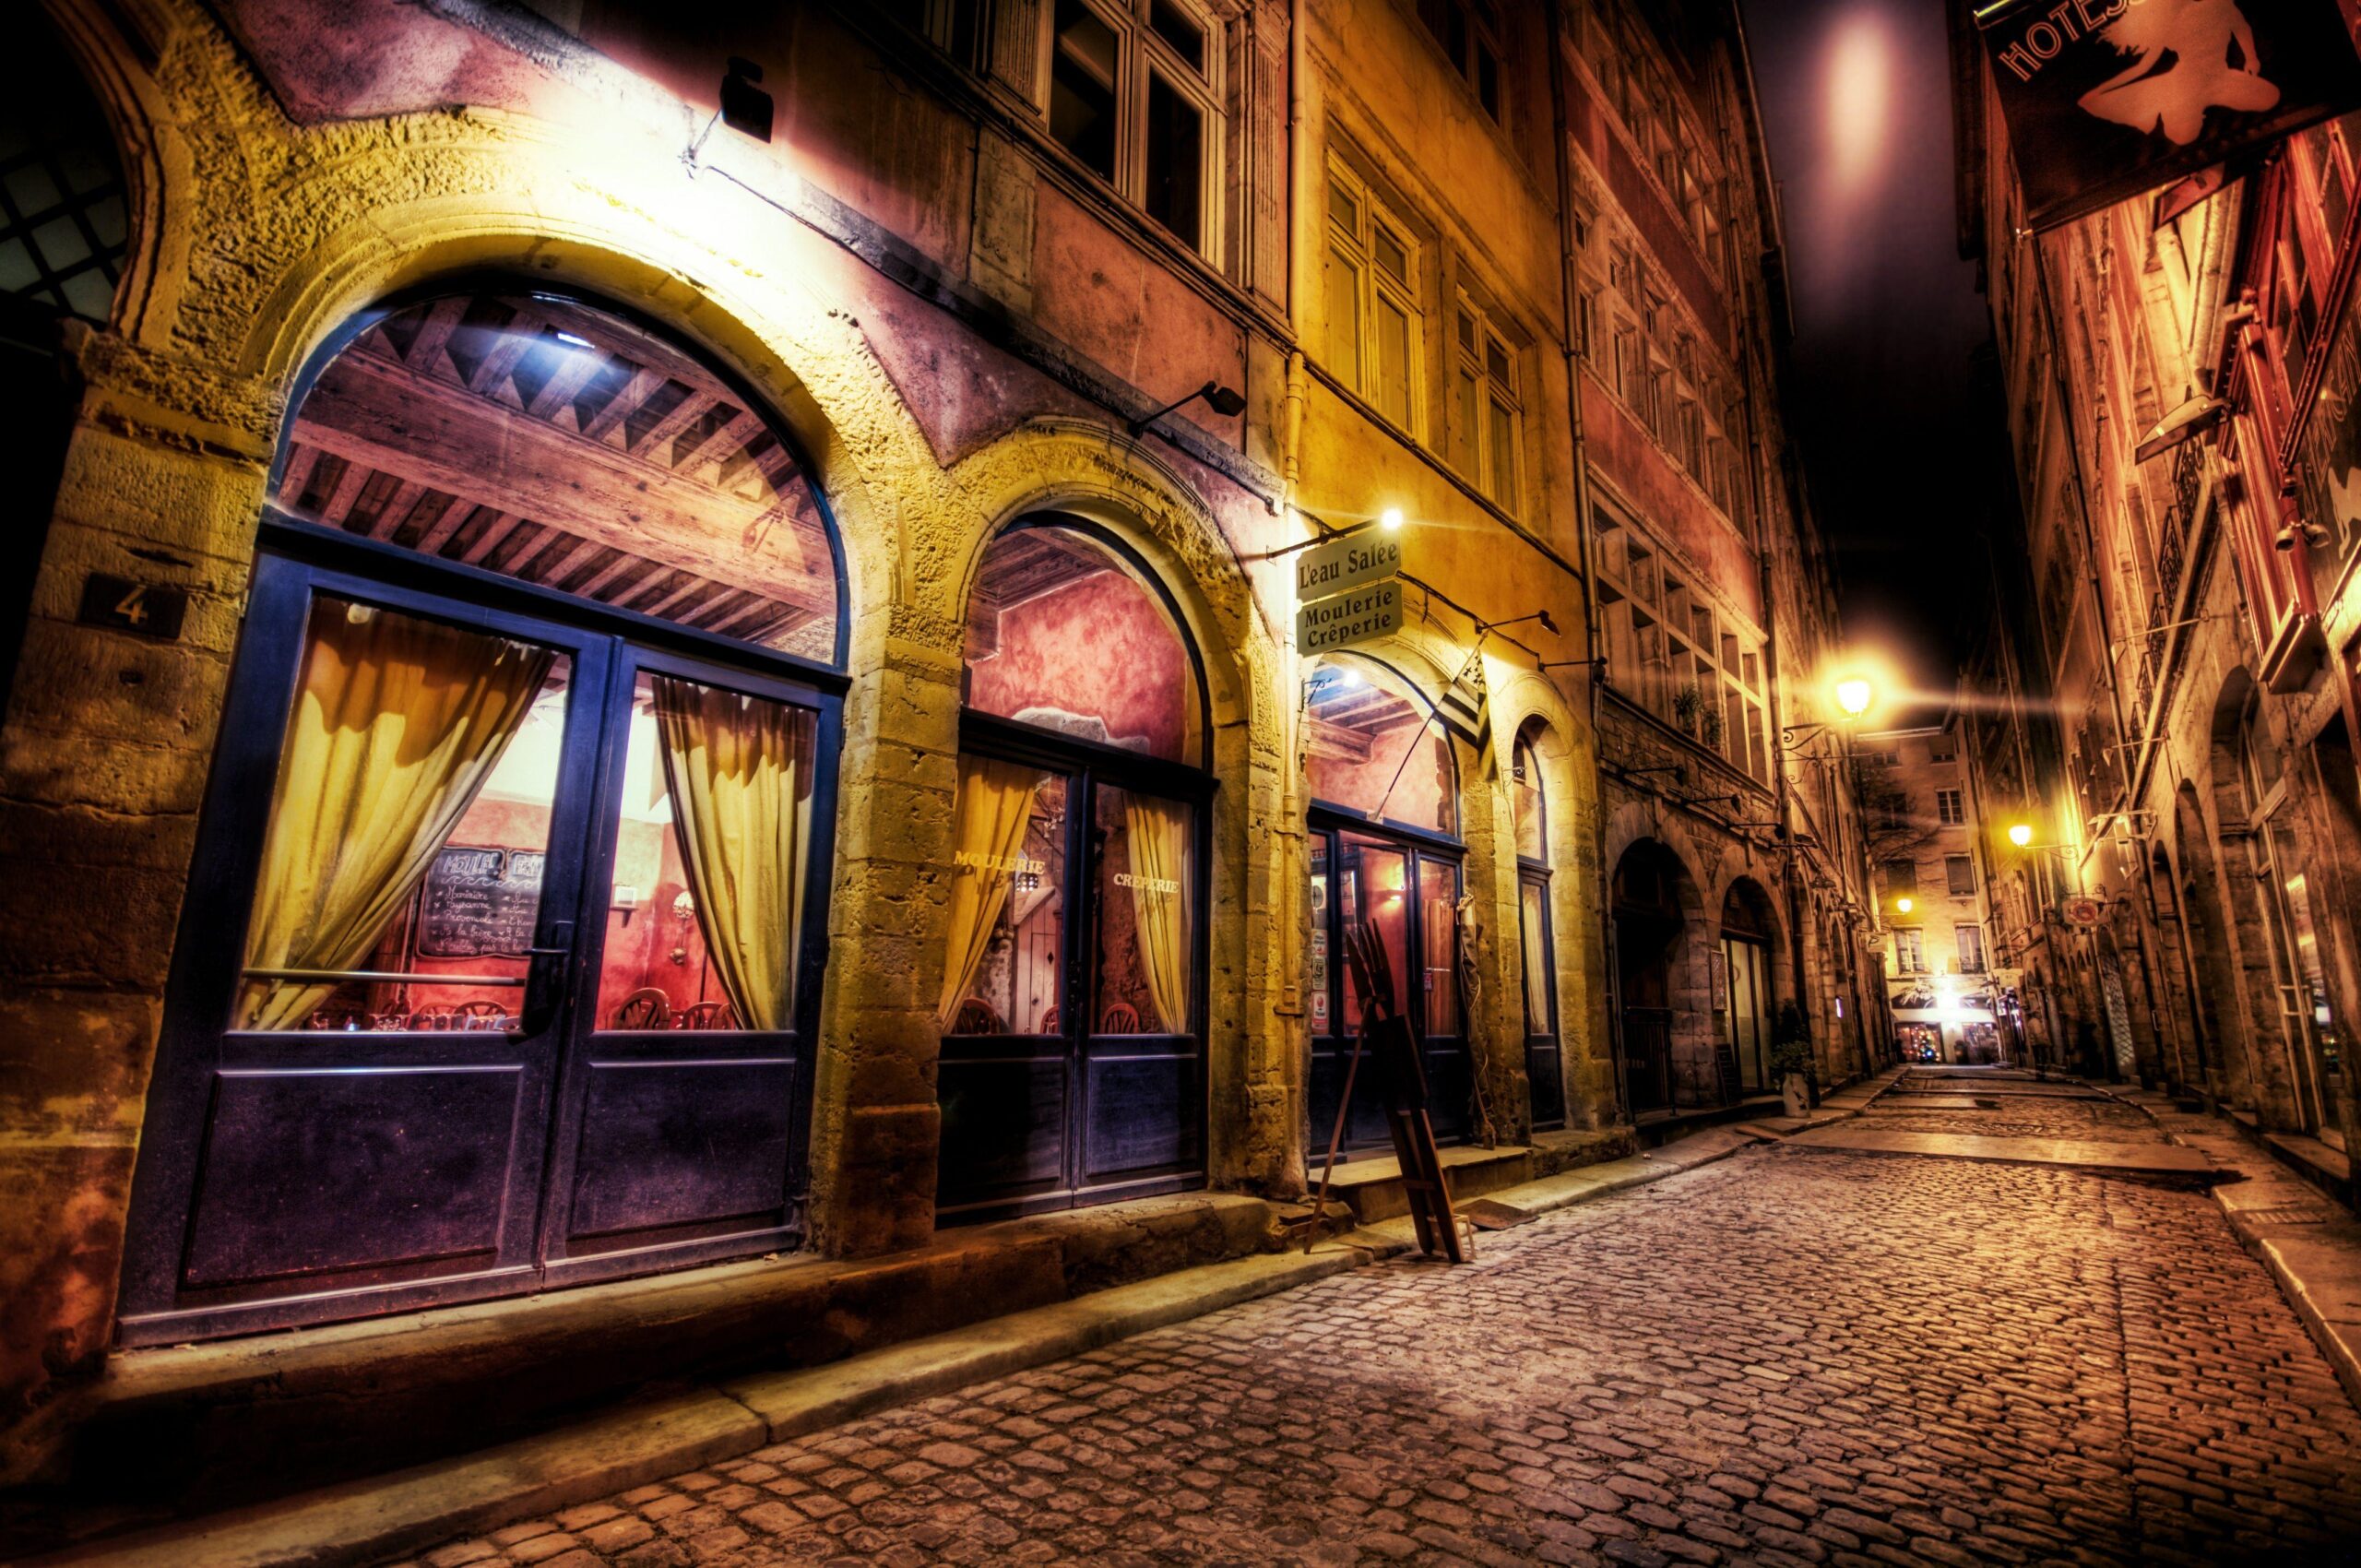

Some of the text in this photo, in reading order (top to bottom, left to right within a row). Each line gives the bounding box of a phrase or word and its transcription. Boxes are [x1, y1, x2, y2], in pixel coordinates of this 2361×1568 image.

[1299, 540, 1397, 589] L'eau Salée
[114, 584, 148, 624] 4
[1304, 590, 1394, 628] Moulerie
[1307, 613, 1392, 647] Crêperie
[953, 850, 1046, 875] MOULERIE
